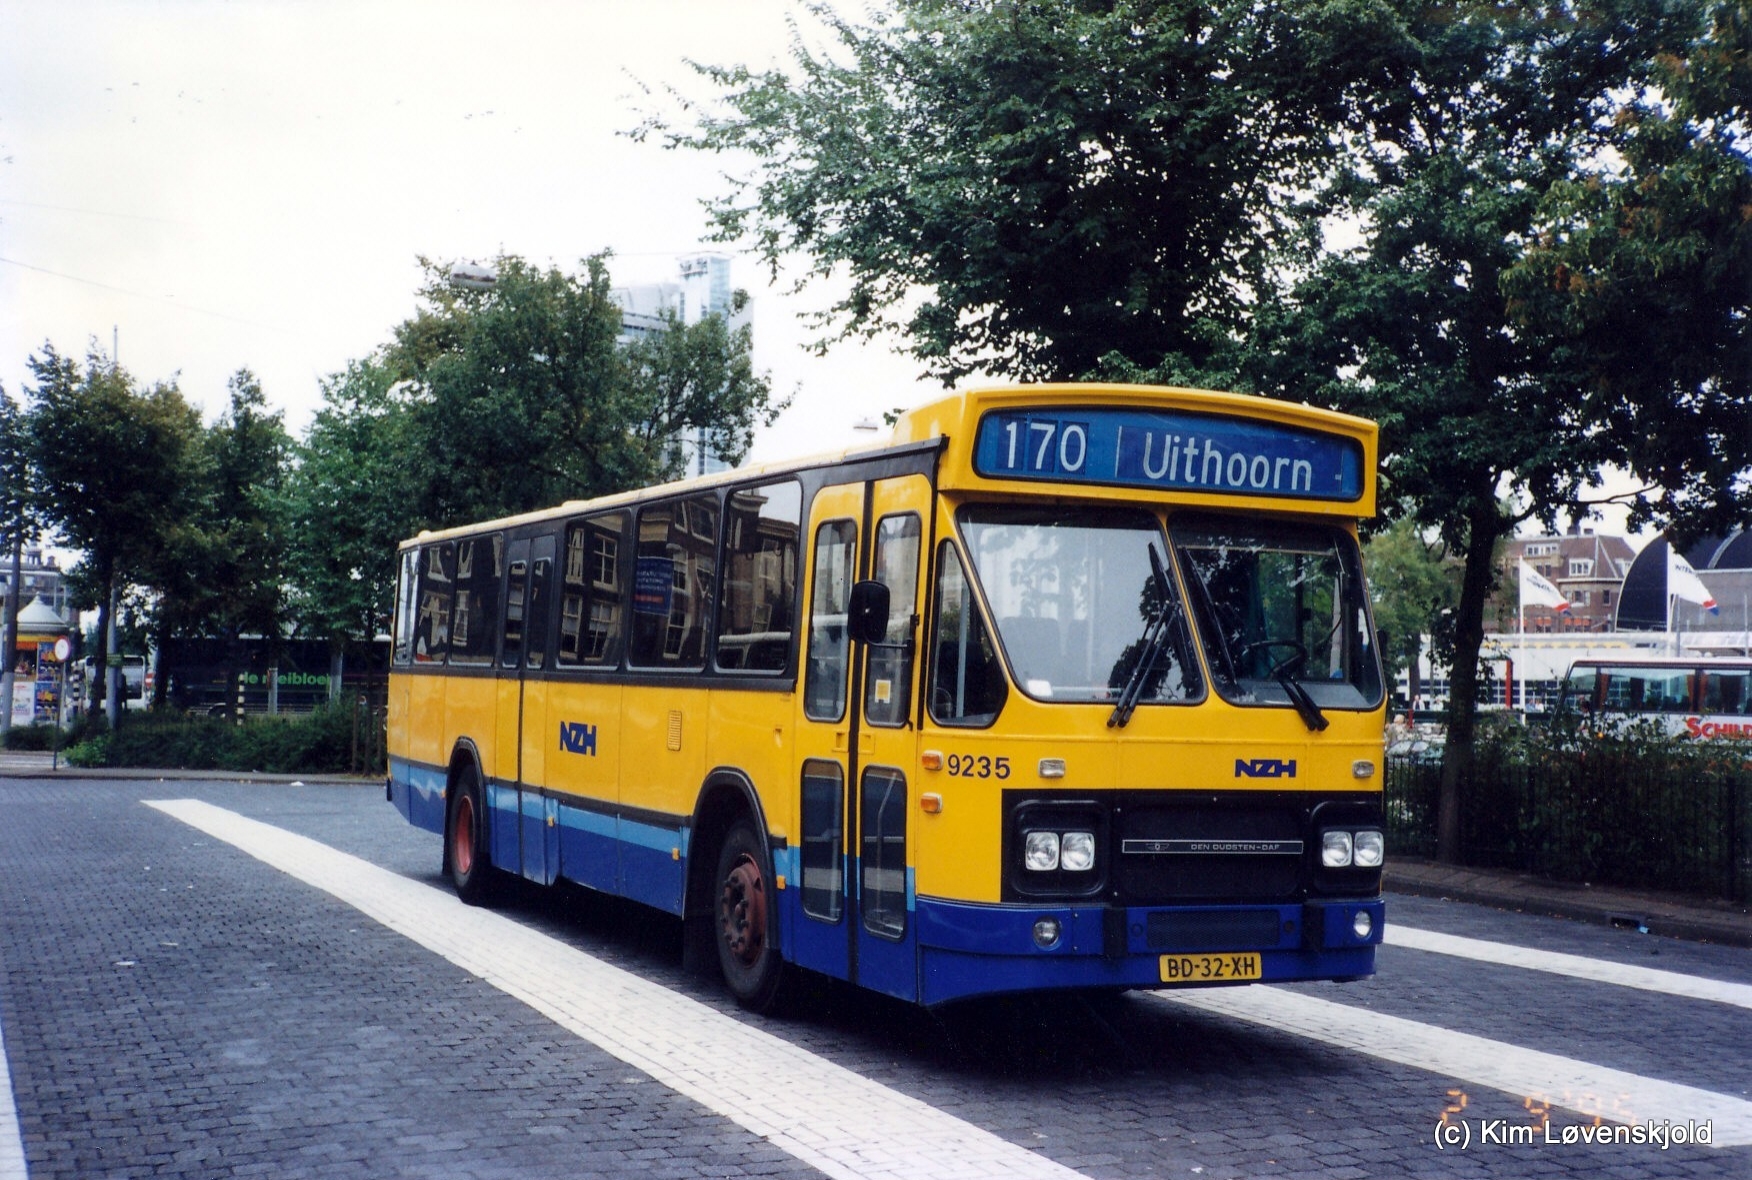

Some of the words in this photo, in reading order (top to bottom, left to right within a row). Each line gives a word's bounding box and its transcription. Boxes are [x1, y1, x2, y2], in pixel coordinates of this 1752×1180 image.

[1005, 420, 1087, 472] 170
[1142, 431, 1313, 492] Uithoorn
[560, 720, 597, 757] NZH
[947, 753, 1011, 780] 9235
[1235, 759, 1297, 778] NZH
[1190, 843, 1210, 851] DEN
[1167, 955, 1256, 980] BD-32-XH
